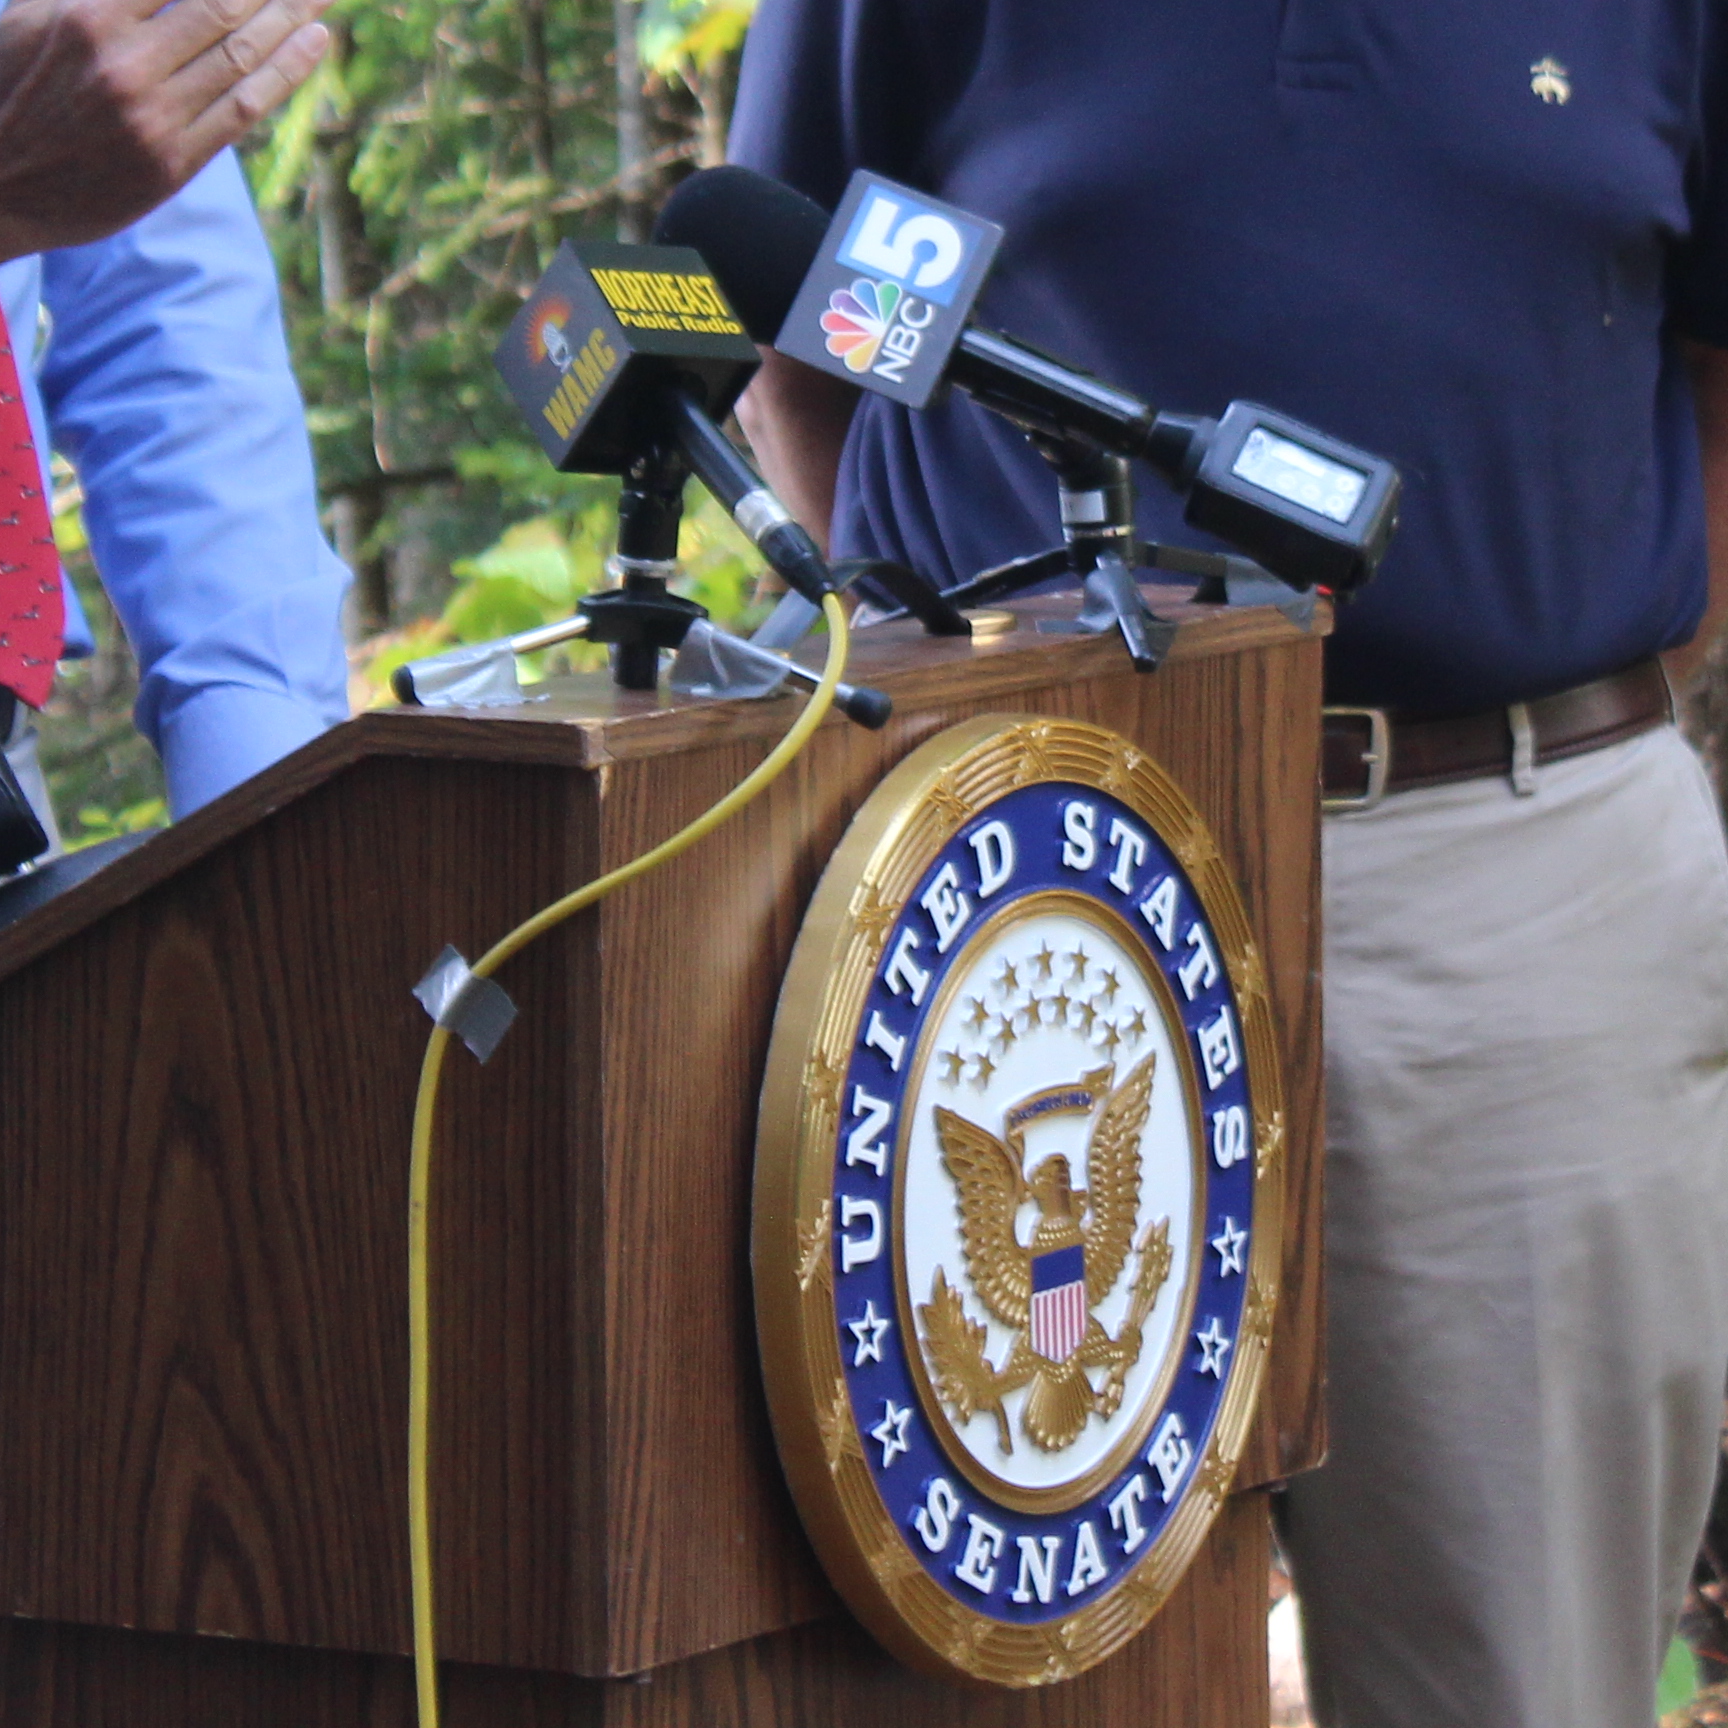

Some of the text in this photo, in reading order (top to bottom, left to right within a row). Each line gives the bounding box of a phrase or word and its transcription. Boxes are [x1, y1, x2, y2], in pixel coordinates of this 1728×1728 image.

[849, 196, 962, 288] 5
[590, 268, 729, 317] NORTHEAST
[614, 311, 743, 335] Public Radio
[541, 327, 617, 441] WAMC
[872, 297, 934, 384] NBC
[840, 799, 1250, 1274] UNITED STATES
[913, 1411, 1193, 1605] SENATE
